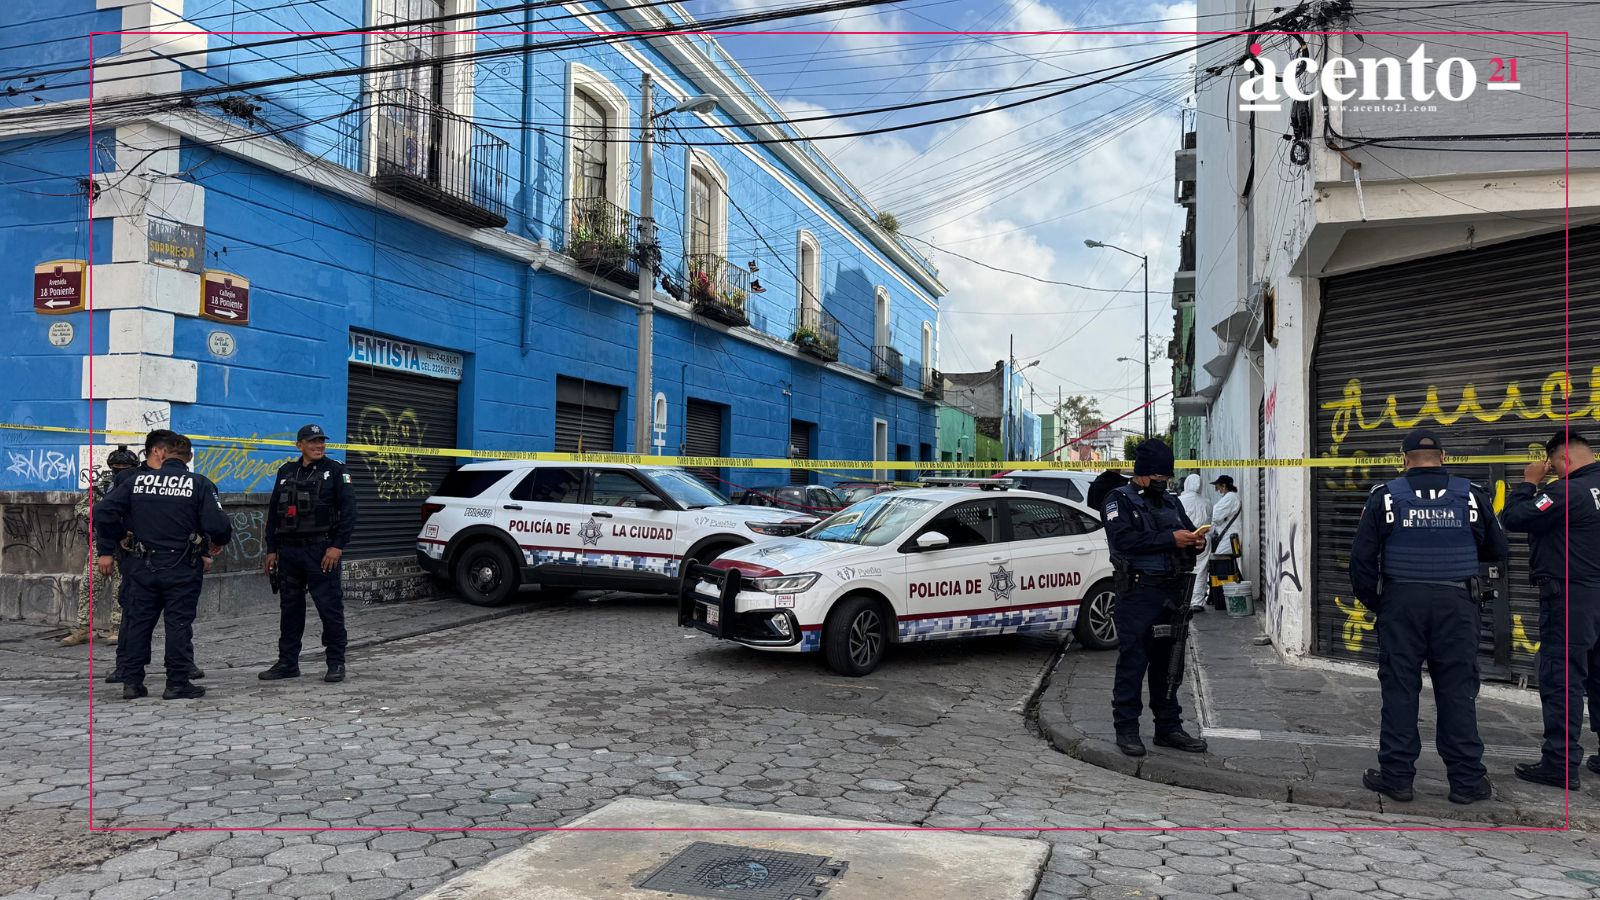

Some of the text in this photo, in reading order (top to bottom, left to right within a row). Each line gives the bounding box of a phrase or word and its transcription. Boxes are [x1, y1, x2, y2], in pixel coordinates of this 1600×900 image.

[149, 240, 195, 259] SORPRESA
[49, 278, 67, 286] Avenida
[40, 286, 75, 297] 18 Poniente
[219, 289, 236, 299] Callejón
[211, 295, 243, 310] 18 Poniente
[135, 474, 194, 489] POLICÍA
[133, 485, 193, 497] DE LA CIUDAD
[1403, 519, 1462, 527] DE LA CIUDAD
[508, 519, 673, 541] POLICÍA DE LA CIUDAD
[964, 579, 982, 594] DE
[1020, 575, 1036, 590] LA
[1039, 572, 1082, 589] CIUDAD
